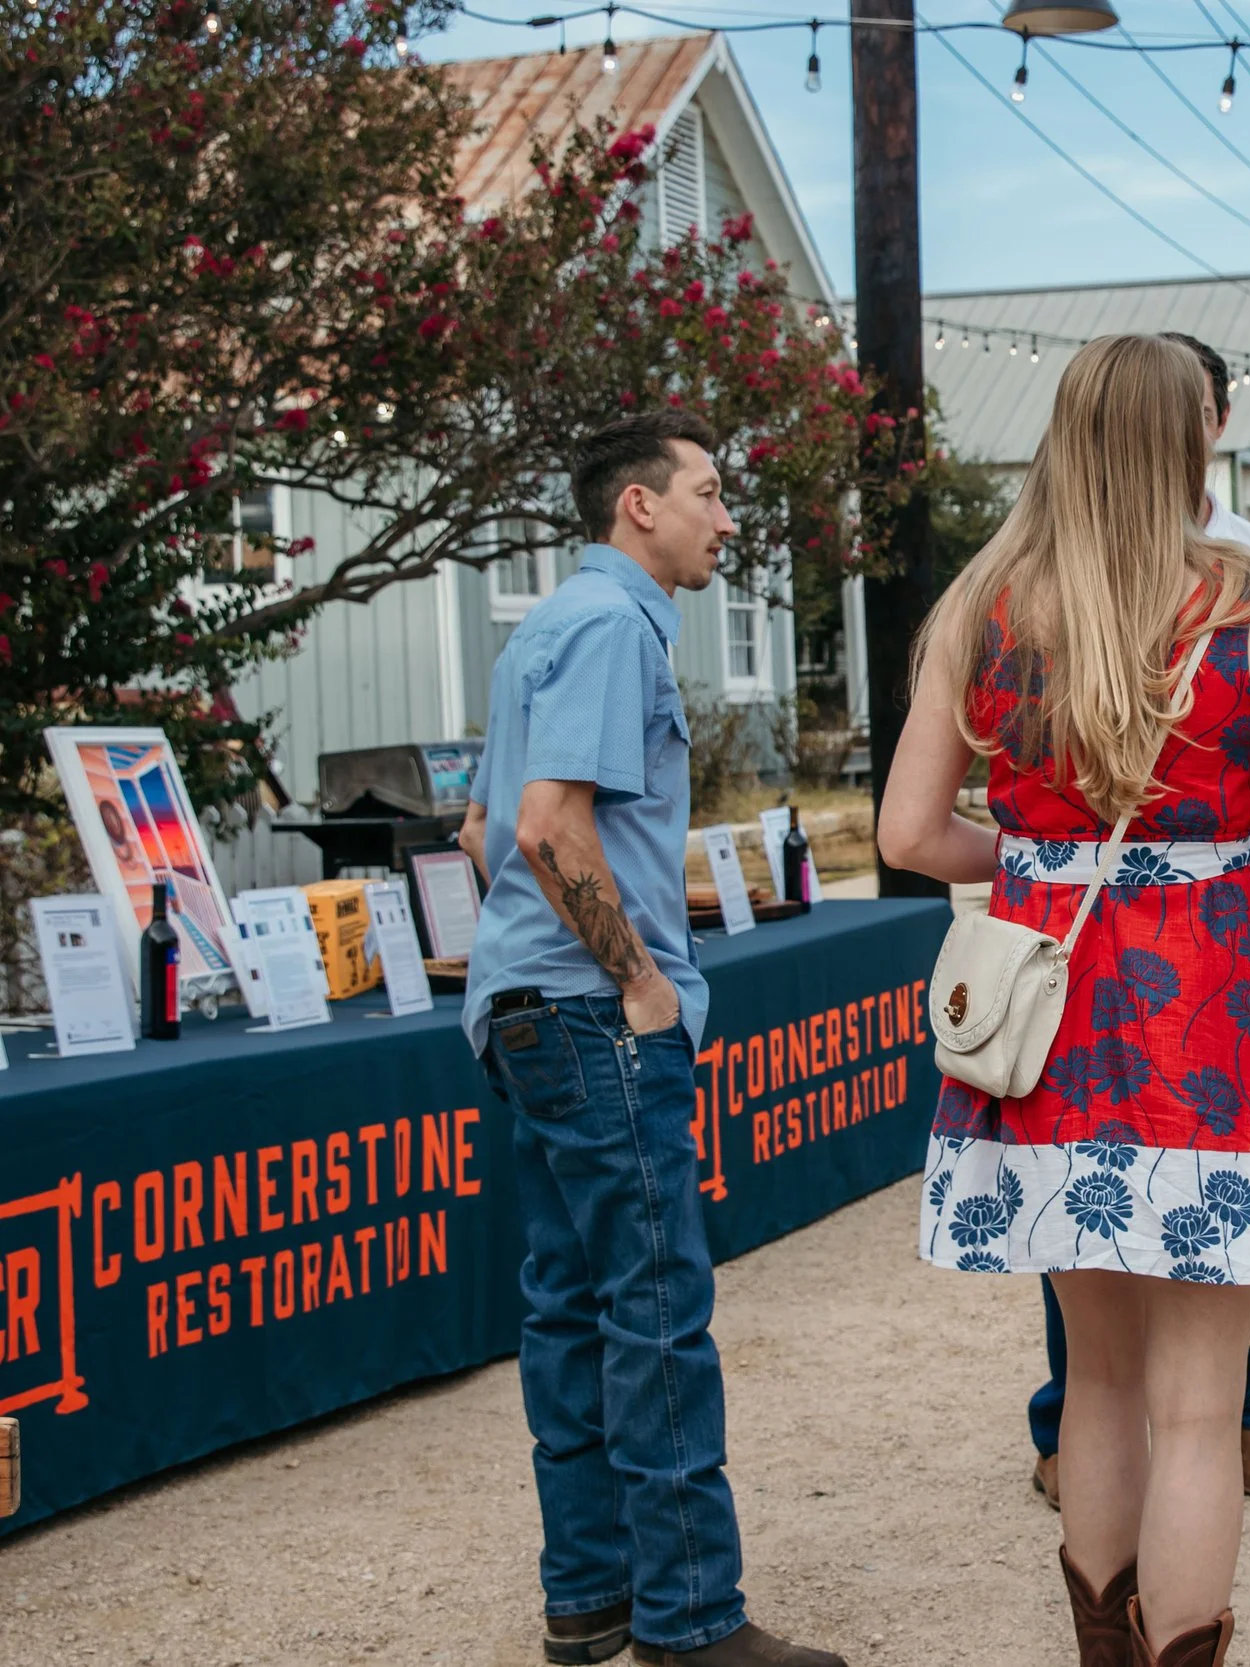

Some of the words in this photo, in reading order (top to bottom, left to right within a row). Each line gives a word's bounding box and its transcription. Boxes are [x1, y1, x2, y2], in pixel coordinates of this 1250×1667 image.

[729, 979, 927, 1117] CORNERSTONE
[752, 1056, 908, 1164] RESTORATION
[93, 1107, 482, 1289] CORNERSTONE
[0, 1246, 41, 1363] R
[147, 1209, 448, 1359] RESTORATION
